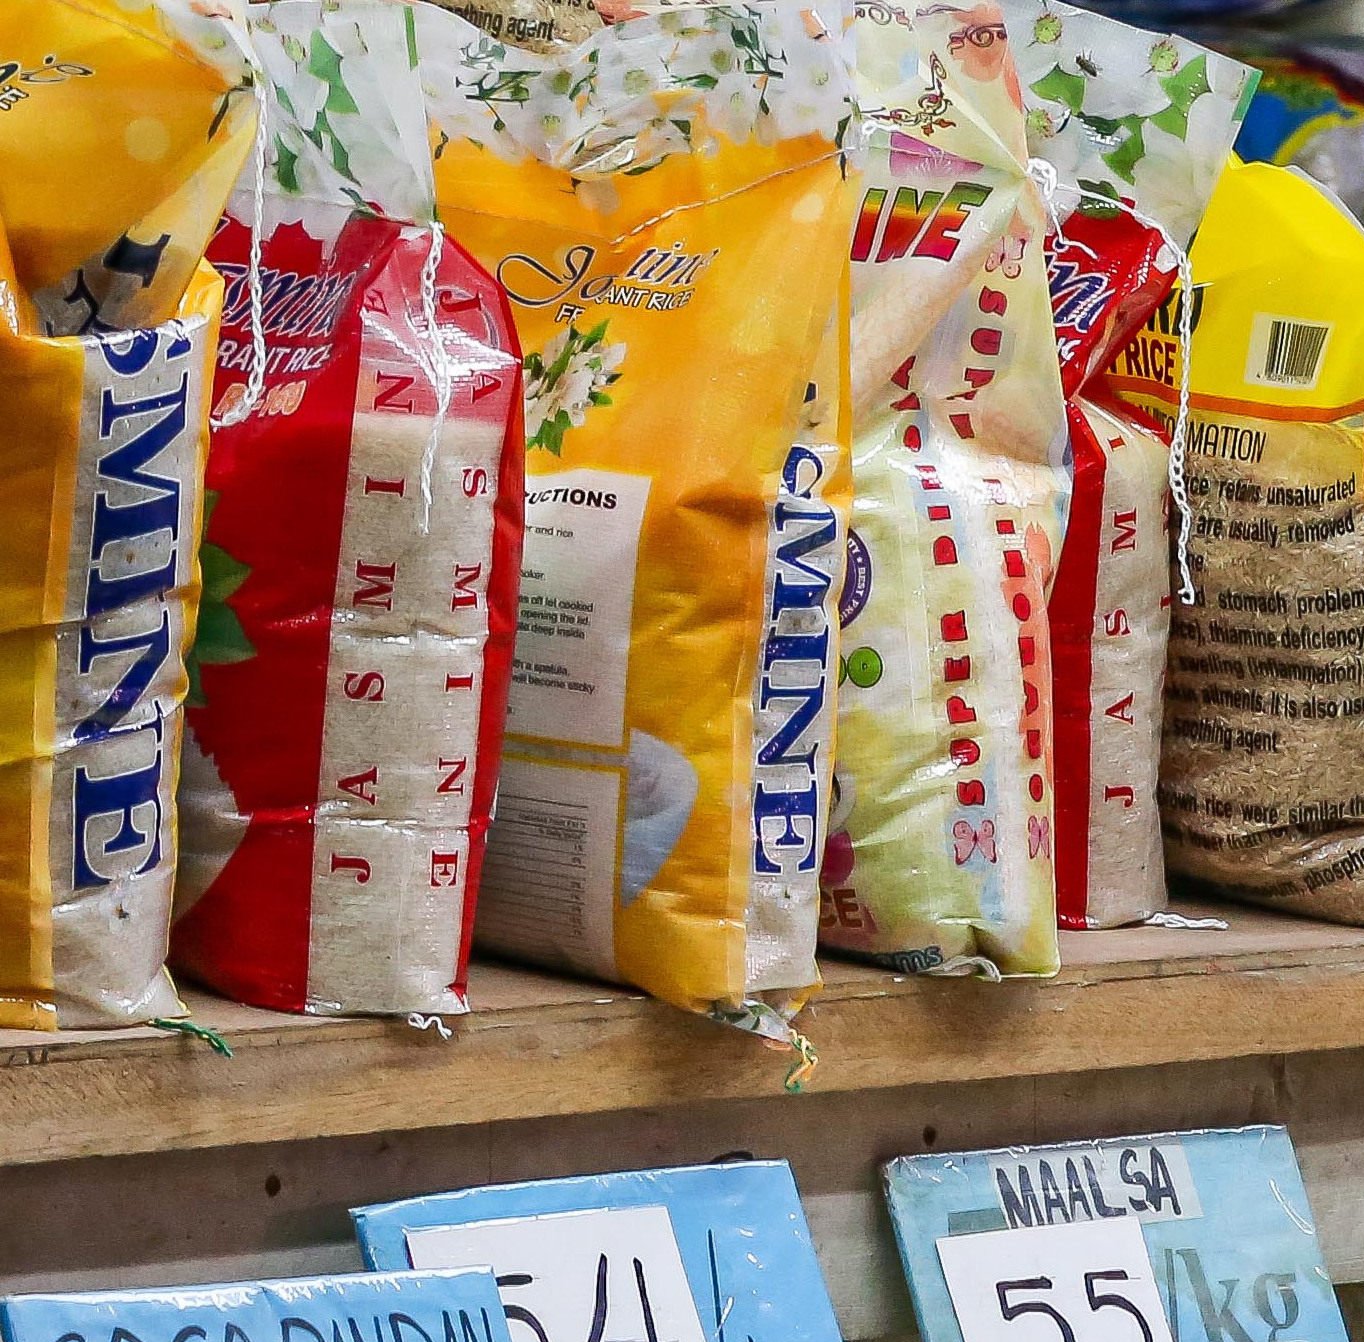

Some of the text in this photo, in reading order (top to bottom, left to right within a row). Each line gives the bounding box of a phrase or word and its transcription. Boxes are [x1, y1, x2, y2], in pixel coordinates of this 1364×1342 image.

[507, 16, 555, 41] agent
[1124, 338, 1178, 387] RICE
[1266, 471, 1357, 507] unsaturated
[1228, 518, 1280, 549] usually
[1286, 511, 1355, 543] removed
[1218, 587, 1288, 614] stomach
[1302, 696, 1337, 719] also
[1236, 728, 1277, 753] agent
[1205, 798, 1233, 818] rice
[1288, 801, 1345, 824] similar
